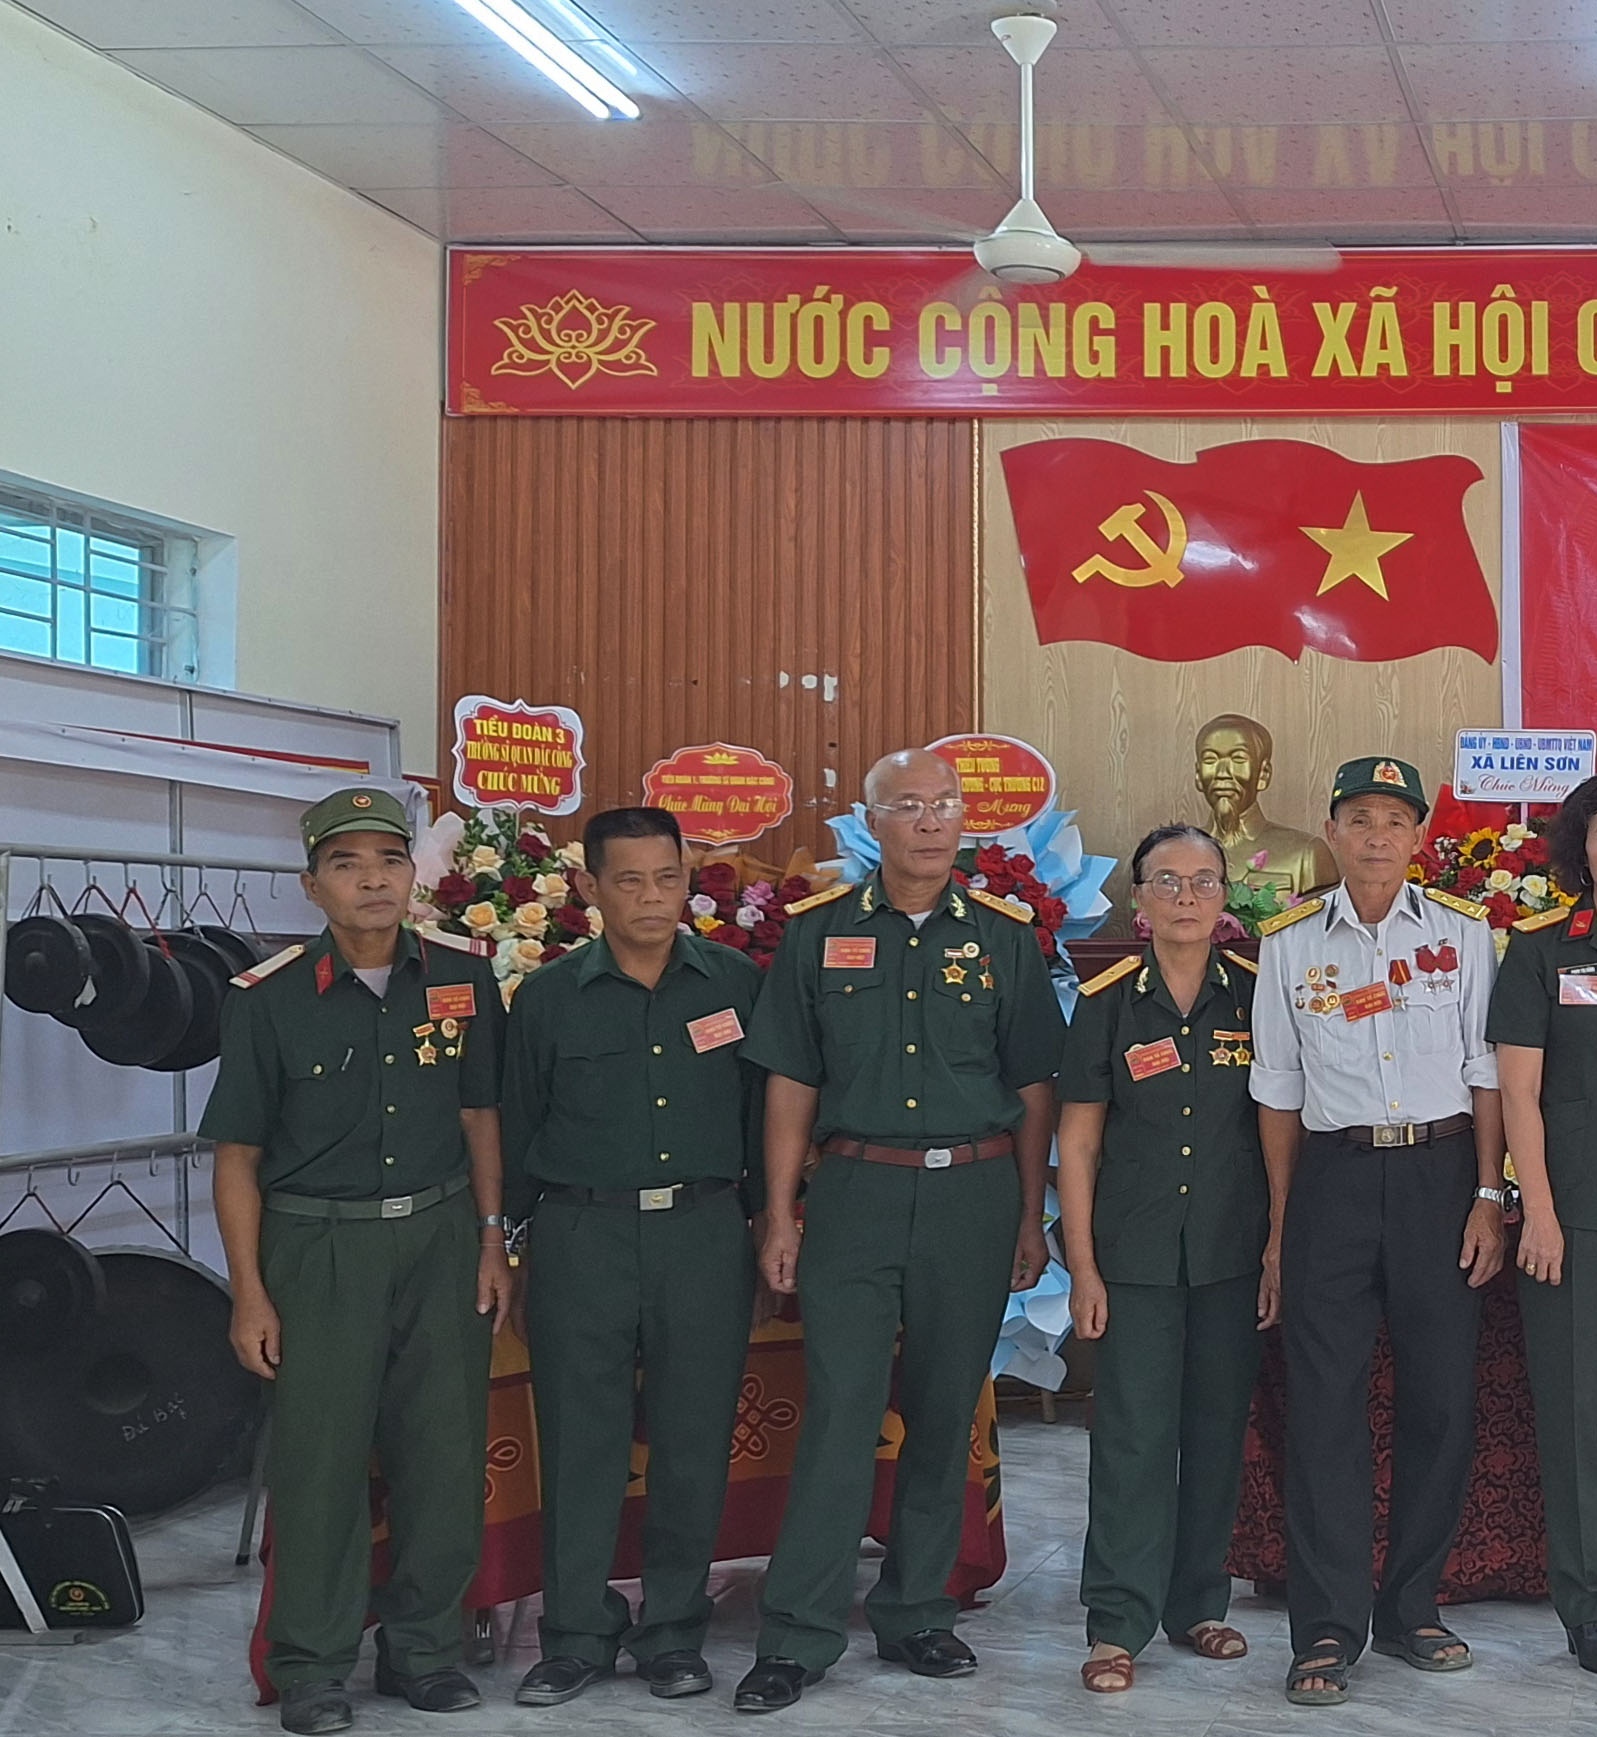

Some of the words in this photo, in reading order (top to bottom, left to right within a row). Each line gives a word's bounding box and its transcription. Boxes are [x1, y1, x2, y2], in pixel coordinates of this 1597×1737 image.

[691, 285, 891, 378] NƯỚC
[918, 286, 1116, 395] CỘNG
[1143, 285, 1288, 378] HOÀ
[1311, 286, 1408, 377] XÃ
[1433, 284, 1549, 393] HỘI
[473, 715, 508, 738] TIỂU
[512, 722, 553, 743] ĐOÀN
[555, 728, 565, 744] 3
[466, 737, 500, 761] TRƯỜNG
[510, 743, 533, 767] QUAN
[551, 745, 573, 768] CÔNG
[1471, 753, 1494, 770] XÃ
[1500, 753, 1538, 771] LIÊN
[1544, 755, 1580, 771] SƠN
[477, 766, 517, 792] CHÚC
[520, 767, 561, 796] MỪNG
[1478, 773, 1516, 792] Chúc
